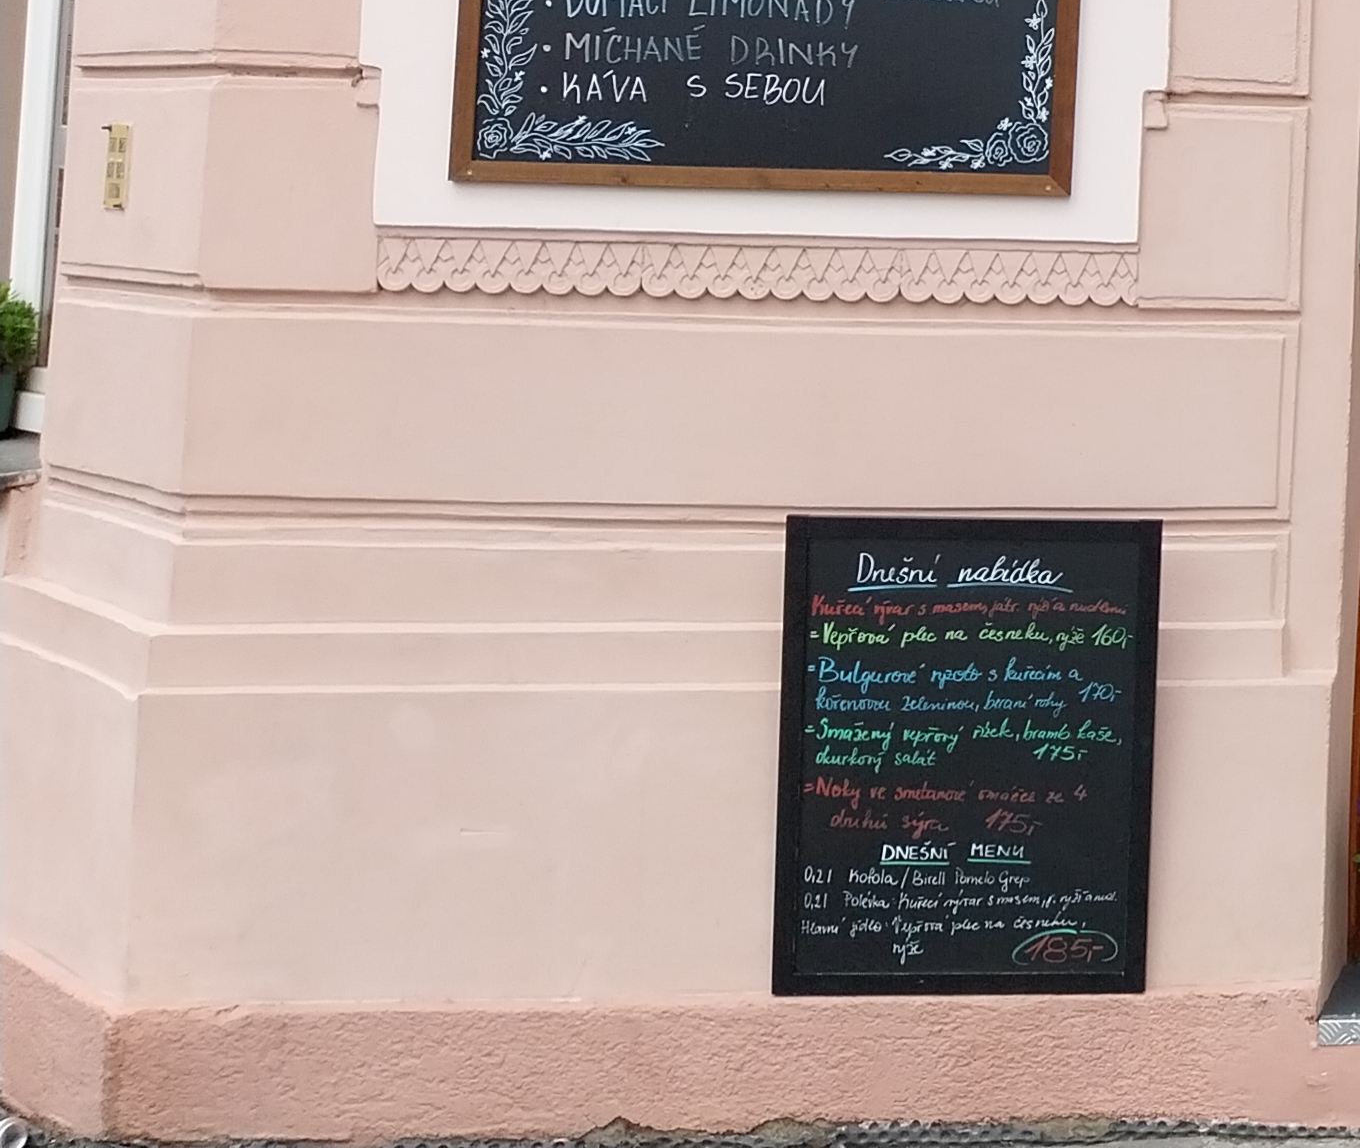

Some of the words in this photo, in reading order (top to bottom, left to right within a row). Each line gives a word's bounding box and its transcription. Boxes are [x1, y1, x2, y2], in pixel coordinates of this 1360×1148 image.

[563, 24, 707, 64] MÍCHANÉ
[730, 36, 859, 69] DRINKY
[563, 69, 649, 105] KÁVA
[687, 74, 708, 100] S
[725, 73, 826, 107] SEBOU
[856, 552, 941, 584] Dnešní
[958, 555, 1064, 585] nabídka
[944, 629, 968, 641] na
[1068, 669, 1084, 681] a
[1074, 784, 1088, 801] 4
[881, 840, 956, 862] DNEŠNÍ
[970, 843, 1025, 859] MENU
[985, 920, 1005, 929] na
